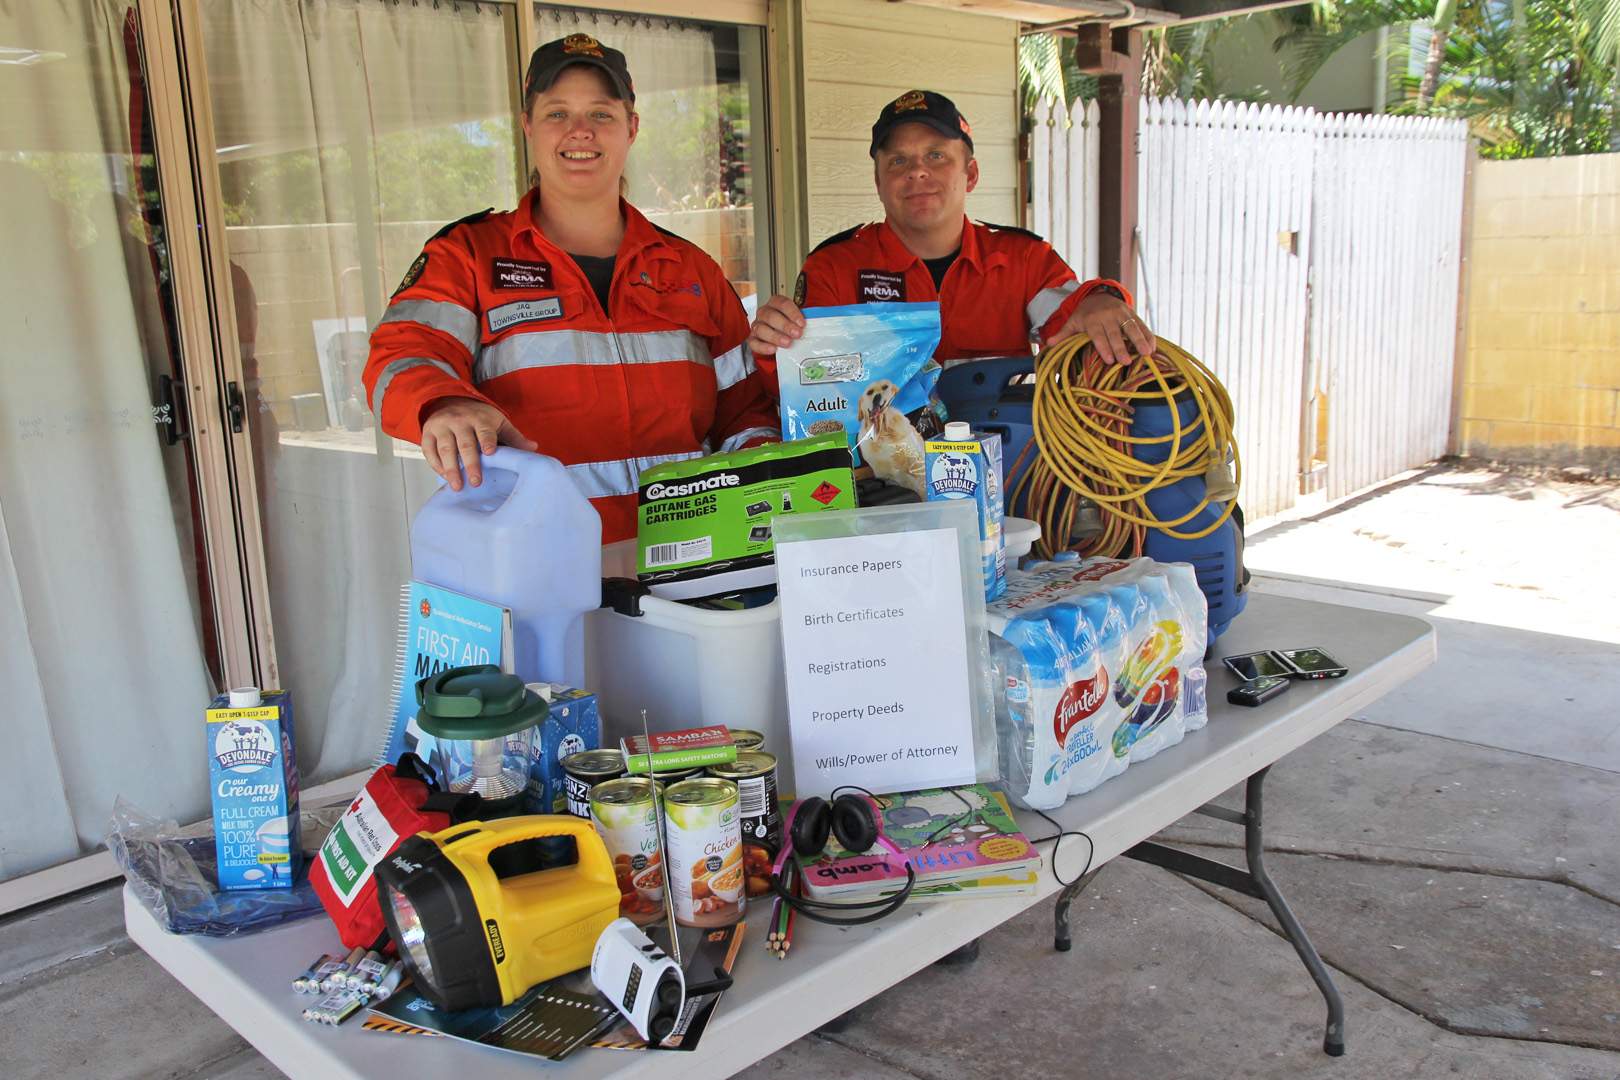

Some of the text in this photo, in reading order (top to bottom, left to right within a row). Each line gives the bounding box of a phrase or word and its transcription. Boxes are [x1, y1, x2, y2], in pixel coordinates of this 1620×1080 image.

[500, 273, 545, 282] NRMA
[864, 287, 900, 297] NRMA
[493, 308, 558, 327] TOWNSVILLE GROUP
[806, 397, 847, 412] Adult
[646, 473, 739, 498] Gasmate
[934, 480, 975, 491] DEVONDALE
[646, 493, 717, 516] BUTANE GAS
[646, 504, 717, 526] CARTRIDGES
[800, 559, 902, 578] Insurance Papers
[804, 607, 904, 626] Birth Certificates
[417, 625, 490, 666] FIRST AID
[808, 657, 887, 675] Registrations
[812, 702, 904, 722] Property Deeds
[220, 750, 273, 765] DEVONDALE
[815, 744, 959, 770] Wills/Power of Attorney
[217, 779, 279, 801] Creamy
[221, 805, 279, 819] FULL CREAM
[222, 830, 256, 844] 100%
[704, 836, 737, 855] Chicken
[224, 844, 257, 859] PURE
[488, 924, 504, 958] EVEREADY
